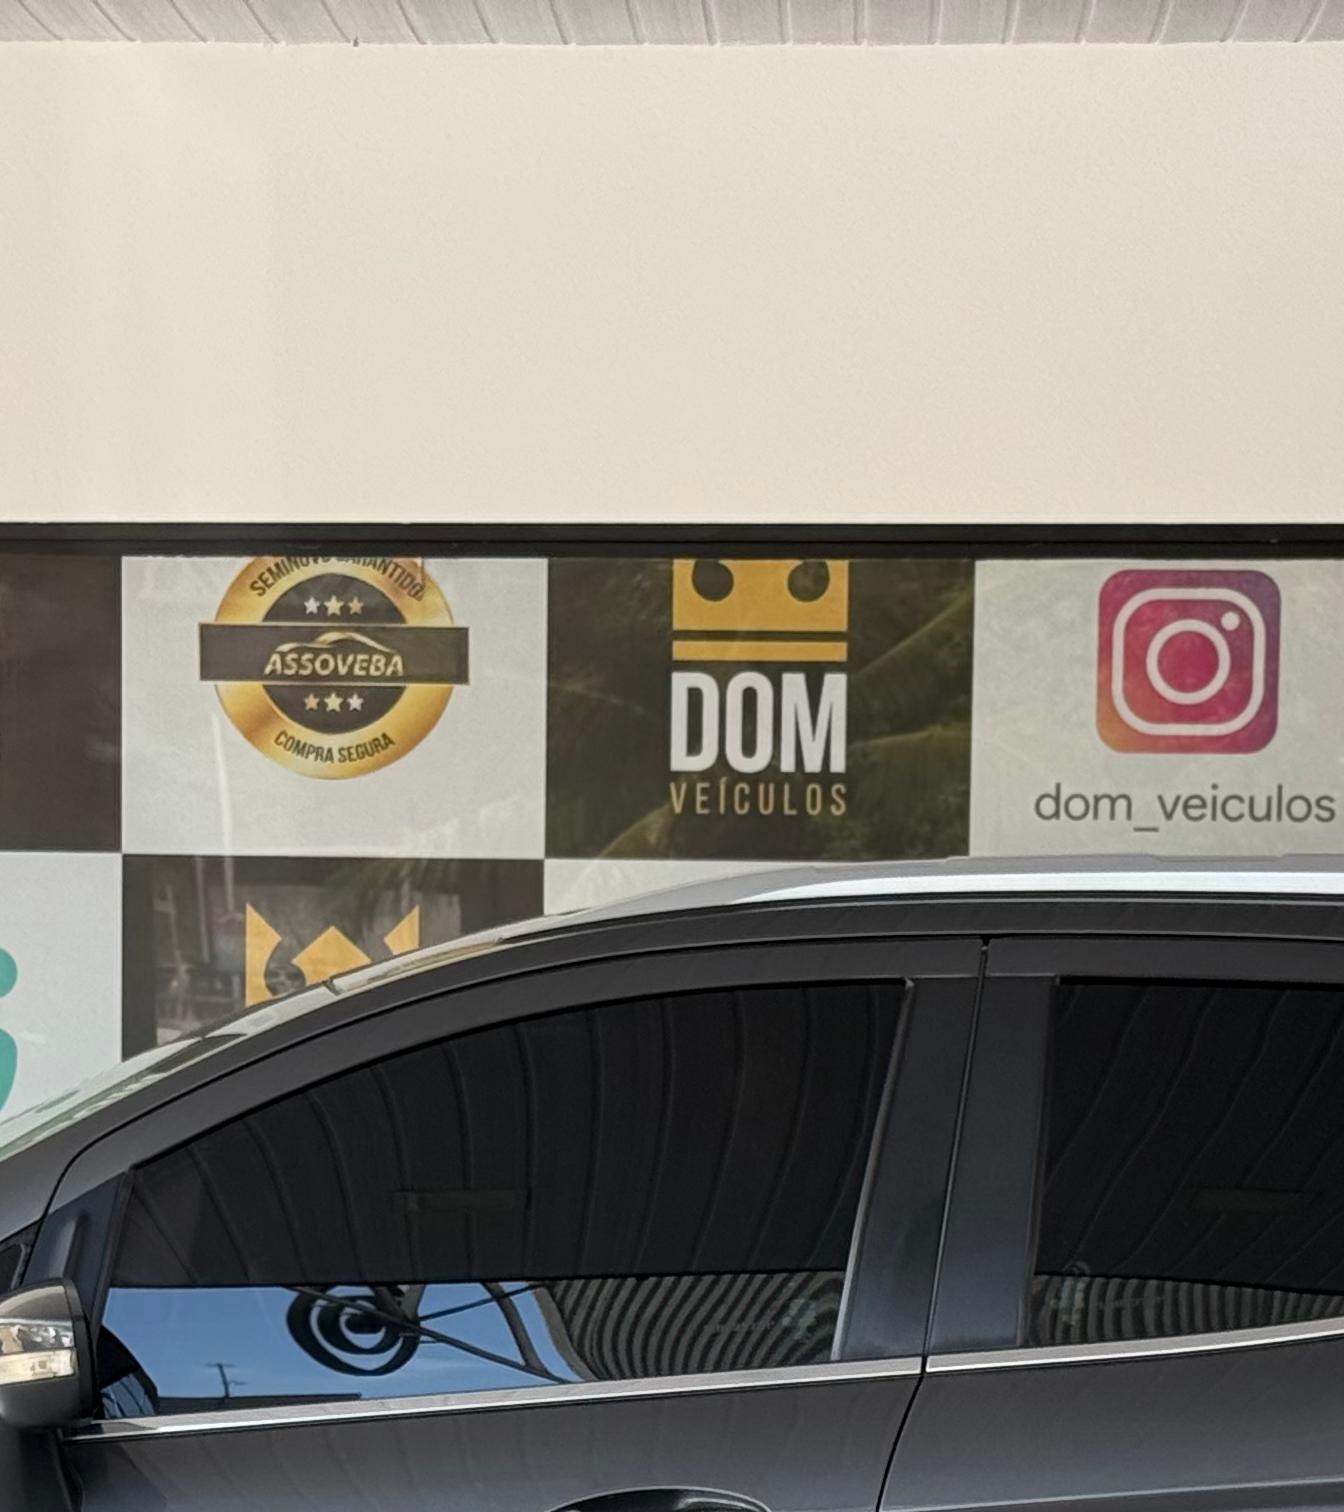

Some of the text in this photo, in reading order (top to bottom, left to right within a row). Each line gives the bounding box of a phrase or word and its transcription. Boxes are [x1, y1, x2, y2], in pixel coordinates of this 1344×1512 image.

[264, 653, 404, 677] ASSOVEBA
[670, 671, 848, 774] DOM
[273, 730, 396, 764] COMPRA SEGURA
[669, 776, 847, 816] VEÍCULOS
[1034, 781, 1337, 833] dom_veiculos
